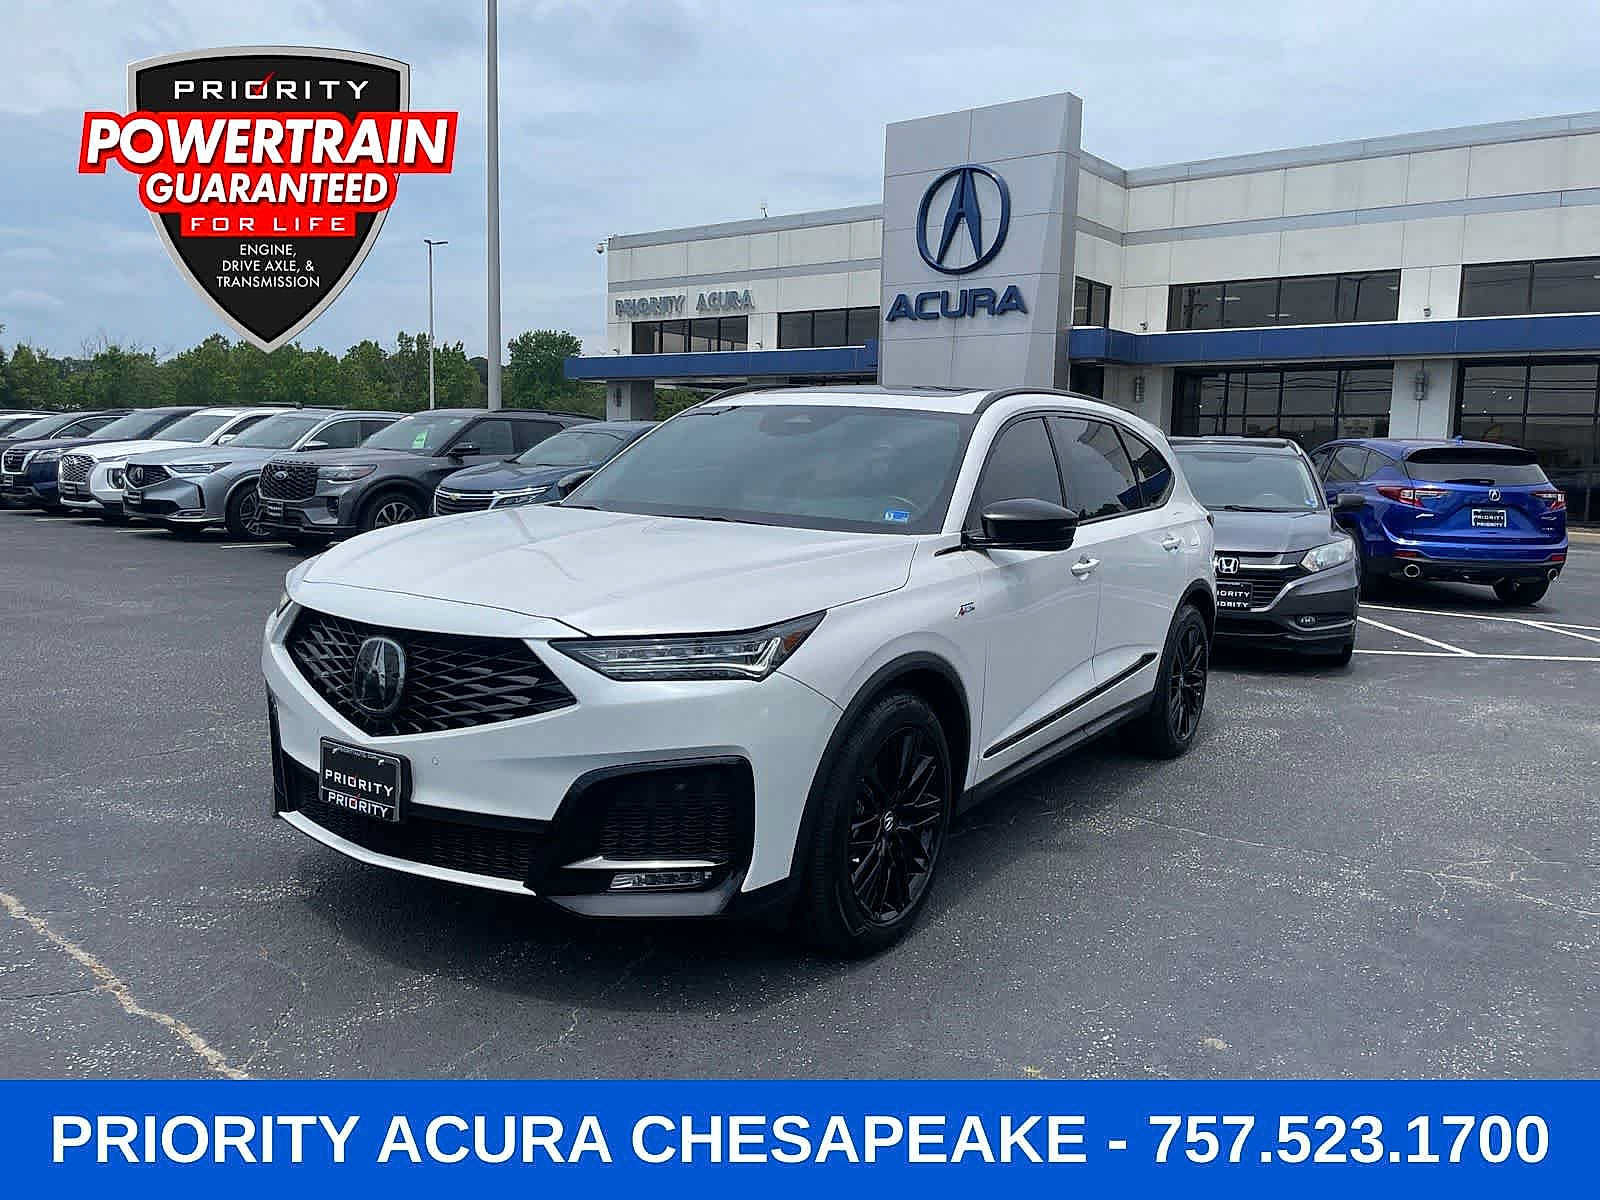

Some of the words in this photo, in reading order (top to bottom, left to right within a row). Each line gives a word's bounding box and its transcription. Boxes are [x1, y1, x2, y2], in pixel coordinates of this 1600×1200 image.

[615, 295, 686, 317] PRIORITY
[695, 289, 755, 312] ACURA
[885, 285, 1028, 322] ACURA
[1216, 590, 1250, 598] IORITY
[325, 769, 394, 797] PRIORITY
[328, 791, 388, 818] PRIORITY
